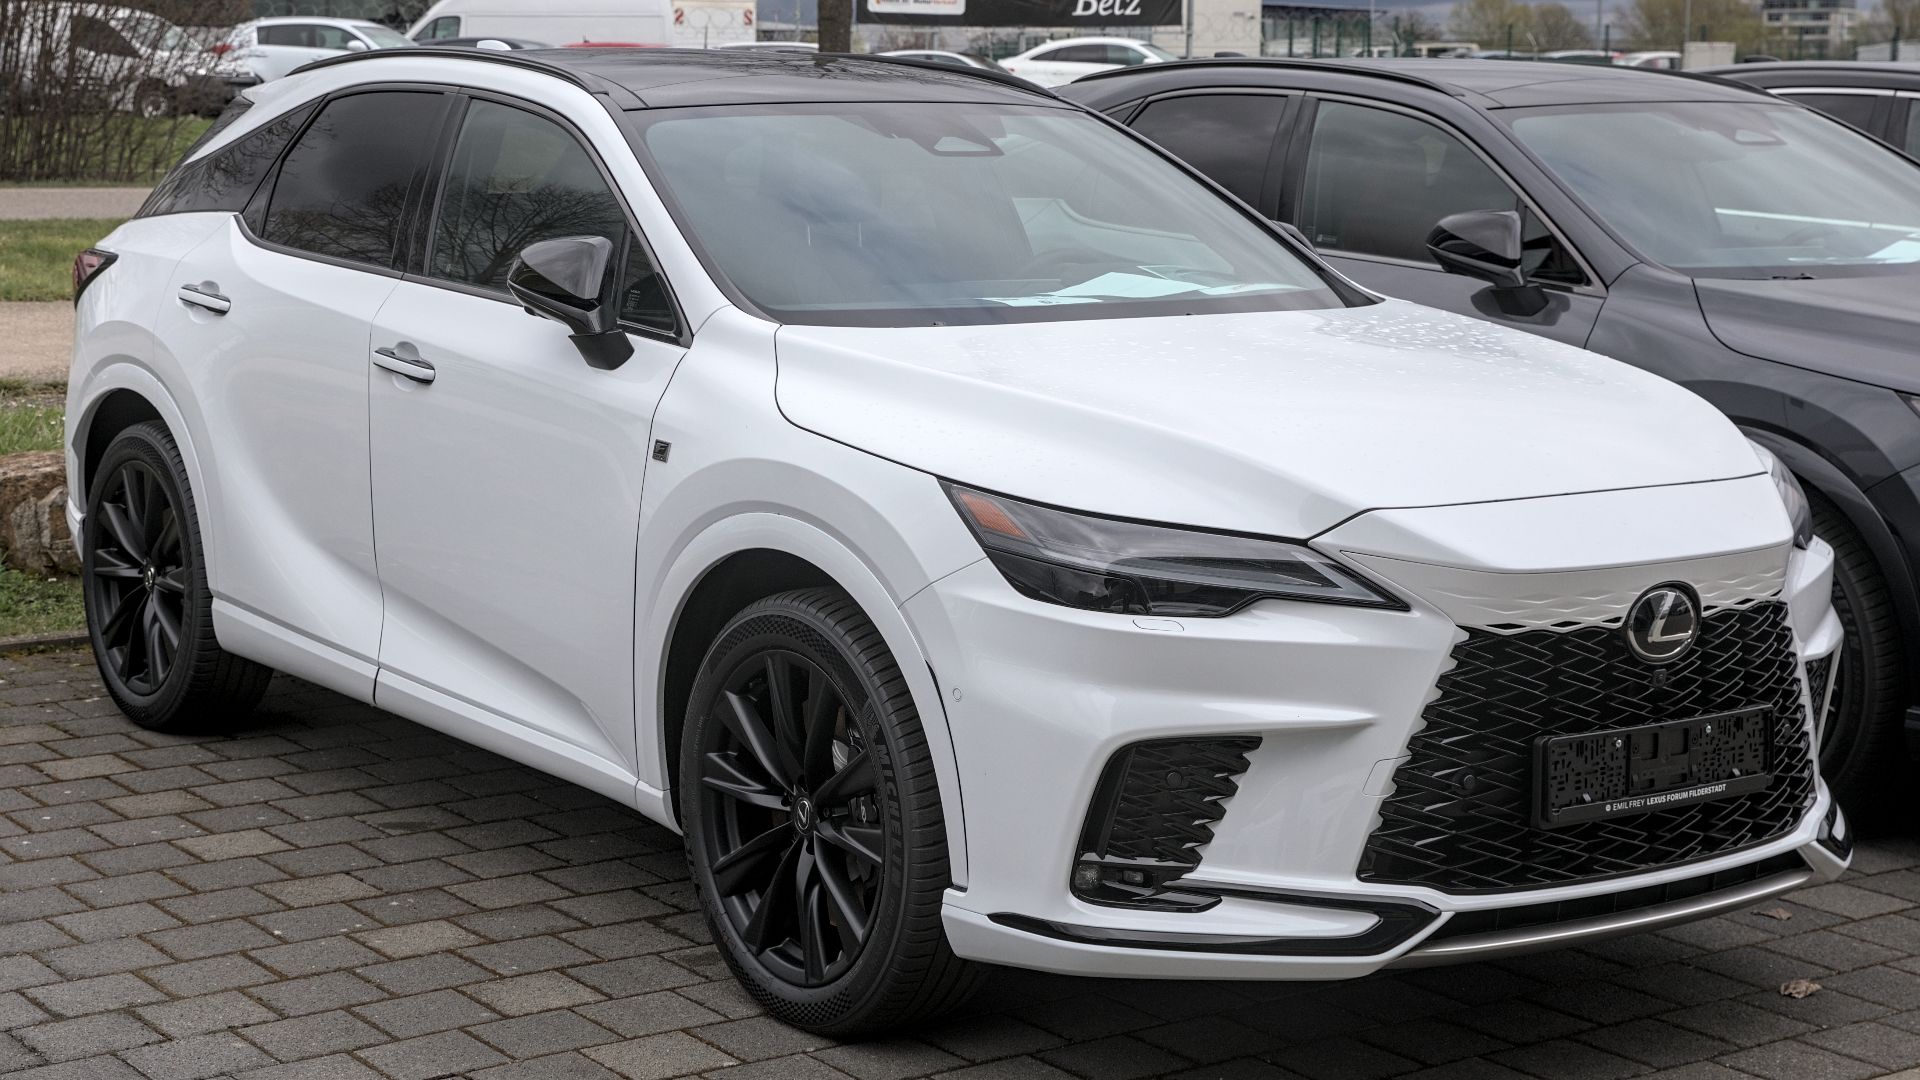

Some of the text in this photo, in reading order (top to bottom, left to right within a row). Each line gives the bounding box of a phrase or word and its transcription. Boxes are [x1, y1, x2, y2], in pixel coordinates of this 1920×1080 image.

[1612, 784, 1727, 811] EMIL FREY LEXUS FORUM FILDERSTADT
